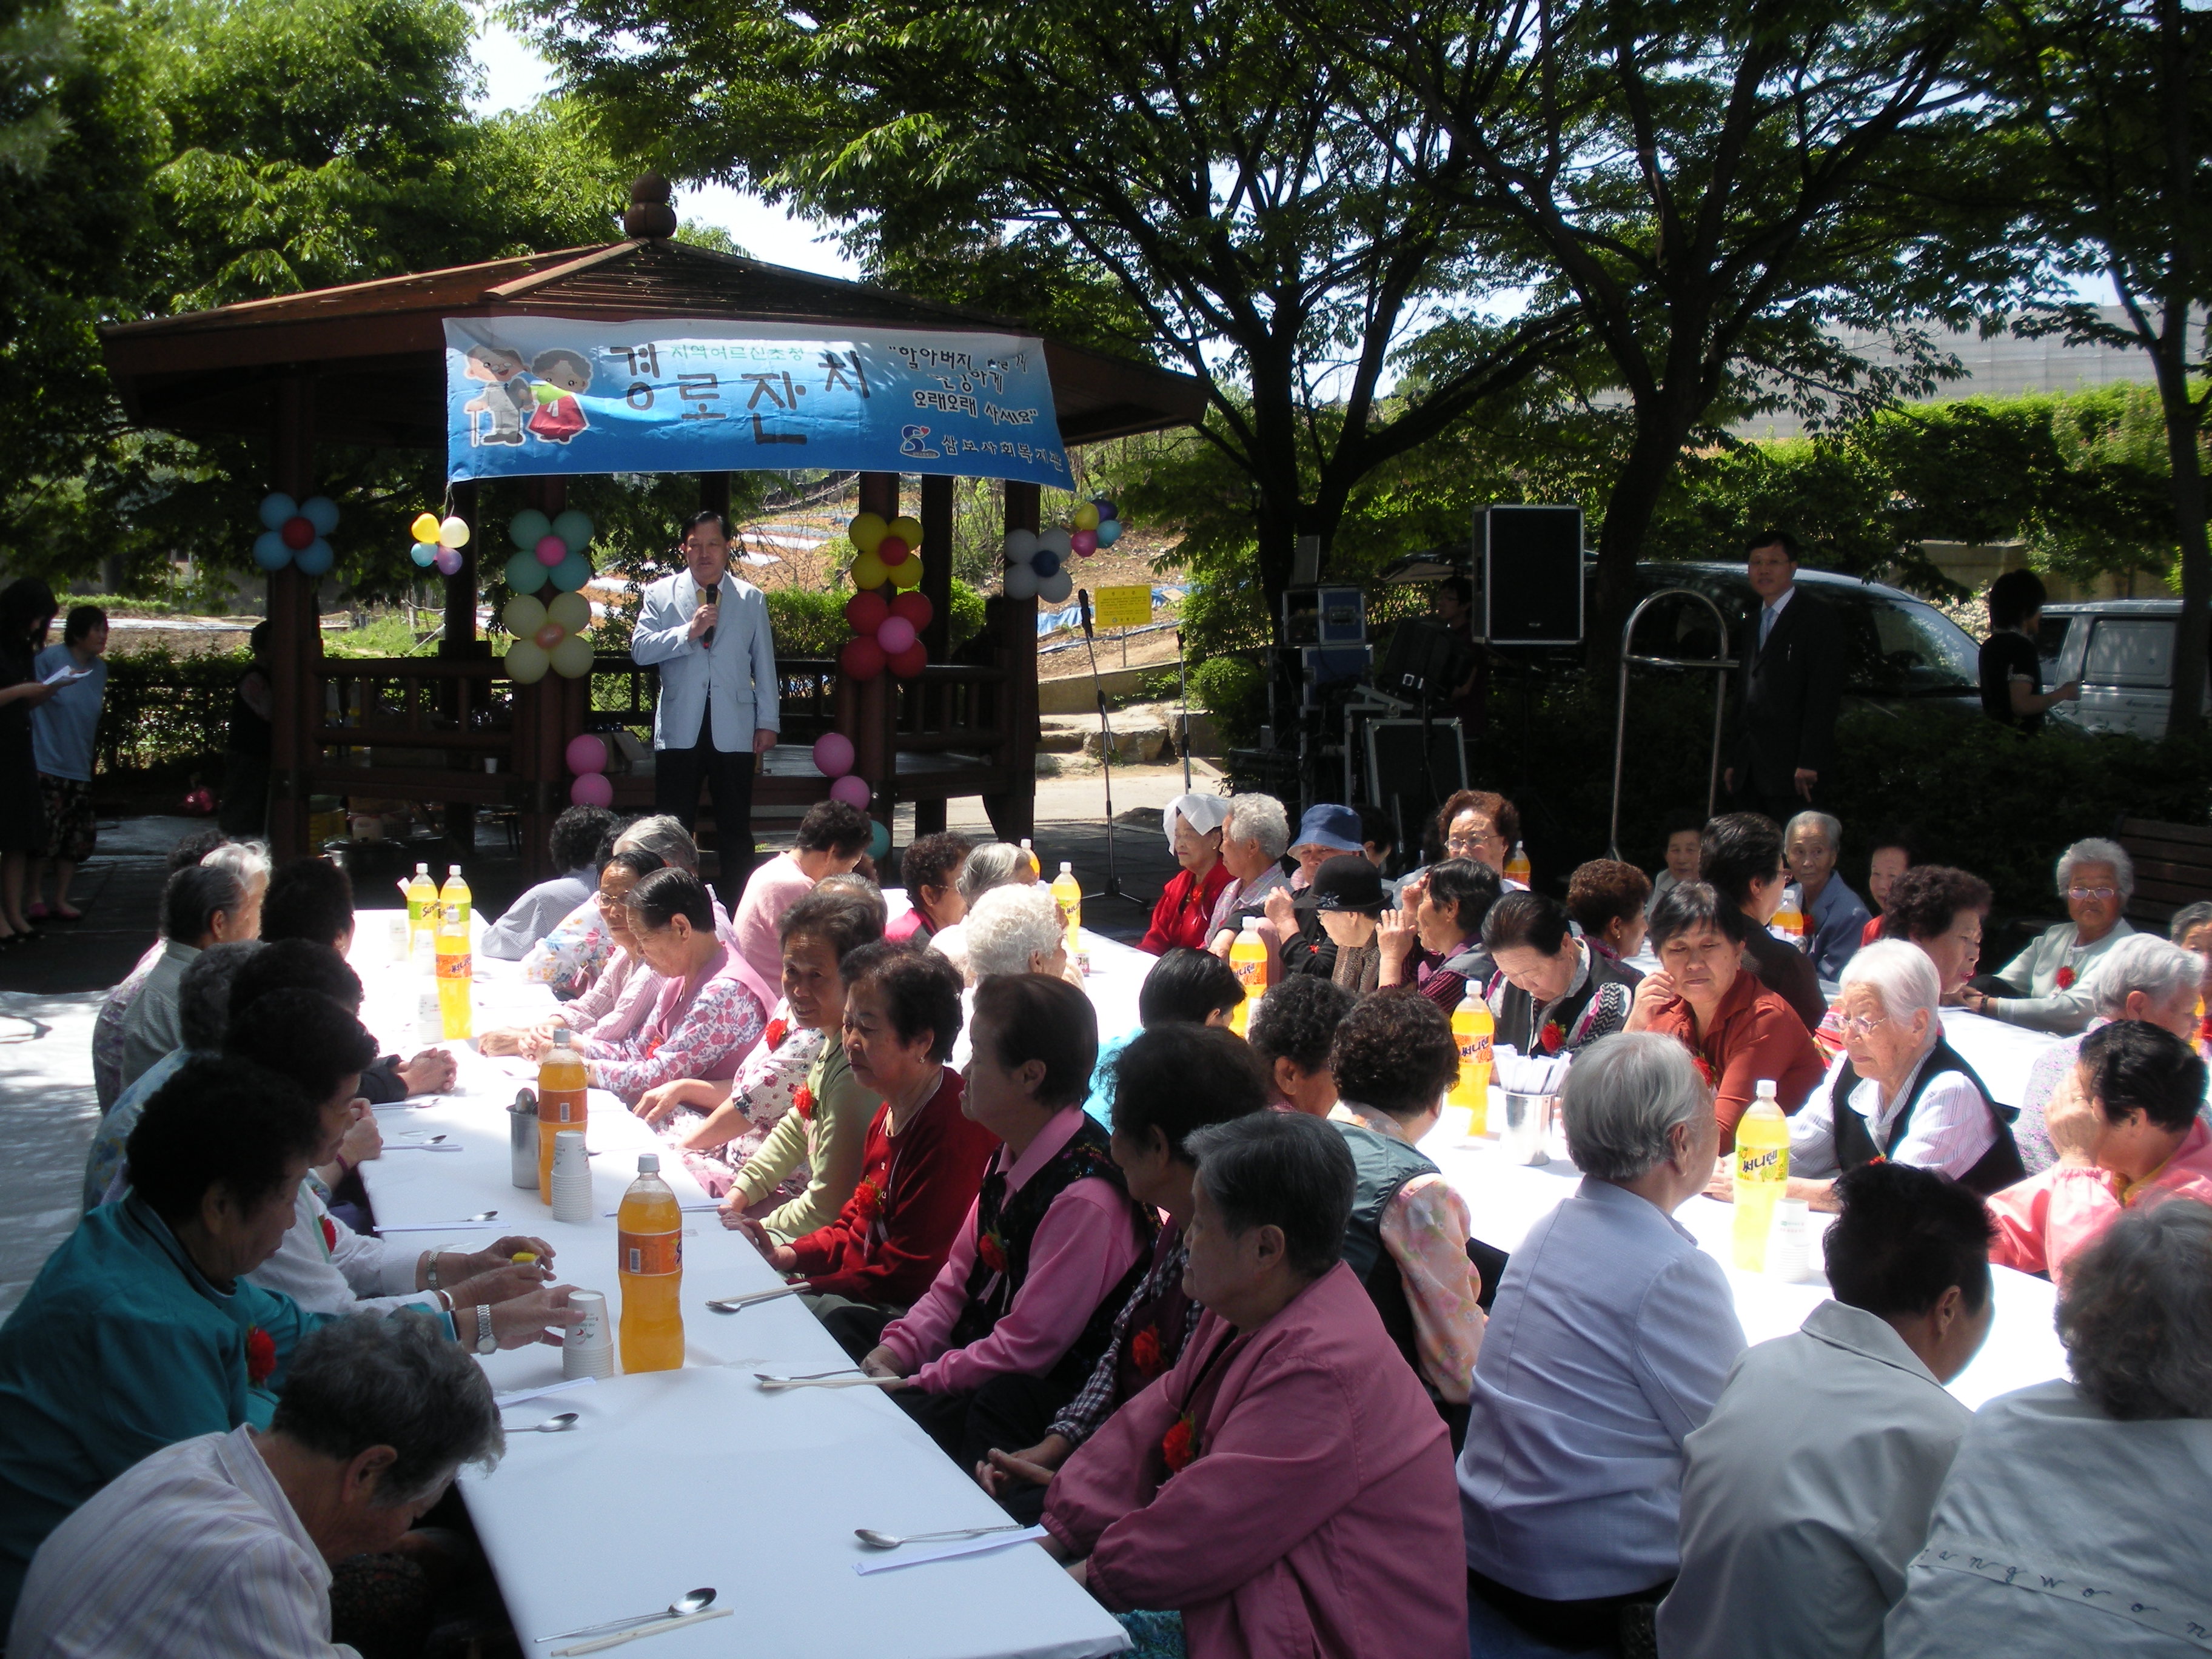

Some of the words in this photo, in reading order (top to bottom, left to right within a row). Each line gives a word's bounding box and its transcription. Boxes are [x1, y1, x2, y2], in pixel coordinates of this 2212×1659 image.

[609, 343, 871, 446] 경로잔치
[913, 390, 977, 417] 오래오래
[985, 401, 1039, 426] 사세요"
[941, 434, 1064, 472] 삼보사회복지관
[1461, 1036, 1489, 1057] 써니텐
[1742, 1149, 1778, 1173] 써니텐
[1759, 1165, 1777, 1182] 10
